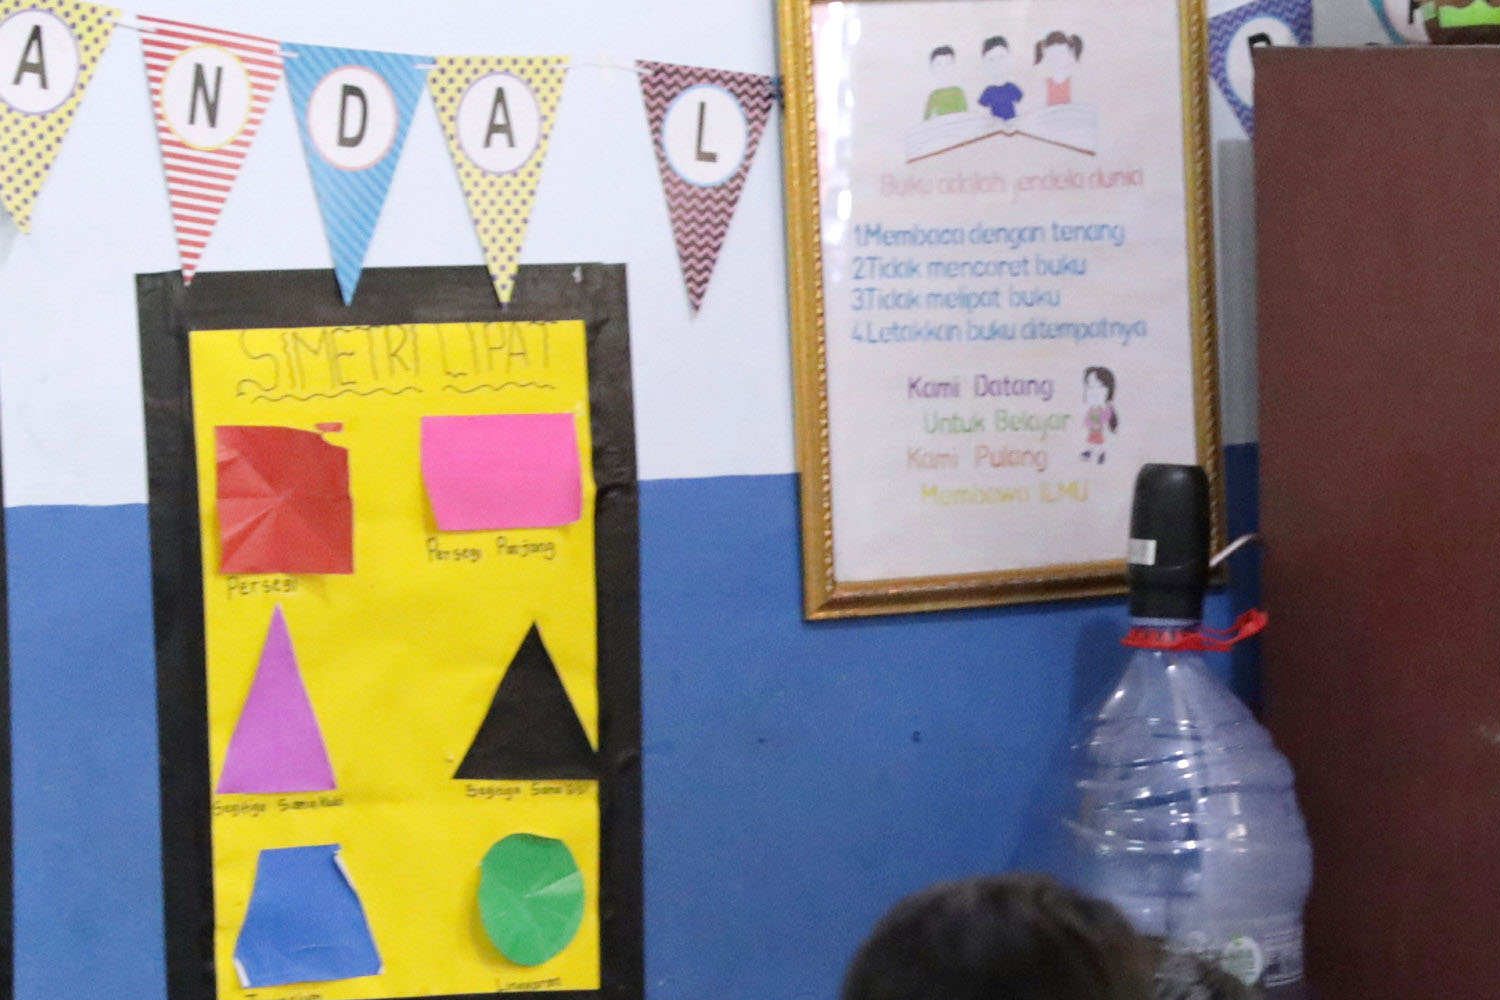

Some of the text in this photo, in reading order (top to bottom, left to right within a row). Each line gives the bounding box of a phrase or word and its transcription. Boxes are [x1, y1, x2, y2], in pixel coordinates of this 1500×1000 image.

[969, 220, 1045, 249] dengan
[1051, 218, 1126, 247] tenang
[1035, 252, 1087, 277] buku
[927, 286, 1000, 313] melipat
[1008, 282, 1060, 307] buku
[965, 316, 1016, 341] buku
[236, 323, 421, 396] SIMETRI
[908, 373, 1055, 402] Kami Datang
[923, 408, 1072, 441] Untuk Belajar
[907, 444, 1049, 473] Kami Pulang
